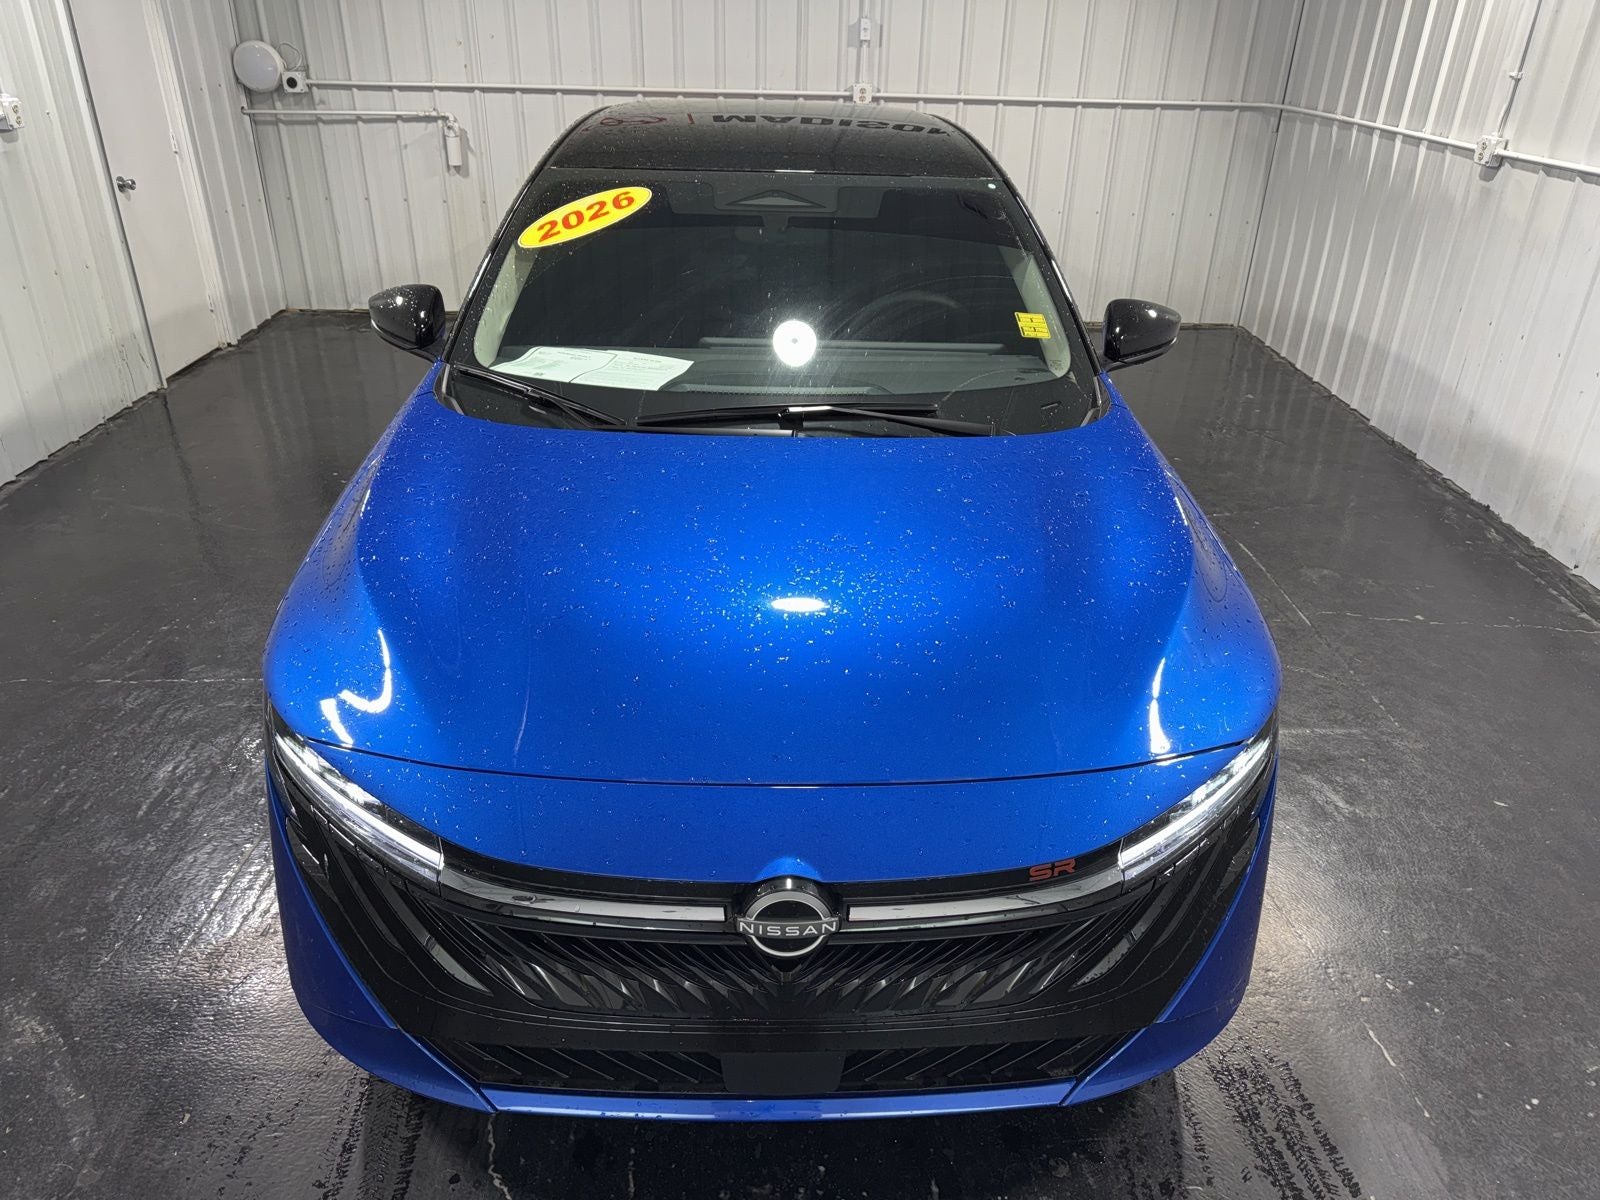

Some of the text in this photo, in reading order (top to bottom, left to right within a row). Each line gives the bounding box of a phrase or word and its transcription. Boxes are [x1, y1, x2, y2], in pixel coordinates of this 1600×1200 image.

[536, 191, 635, 242] 2026
[1029, 858, 1076, 881] SR
[739, 921, 837, 936] NISSAN
